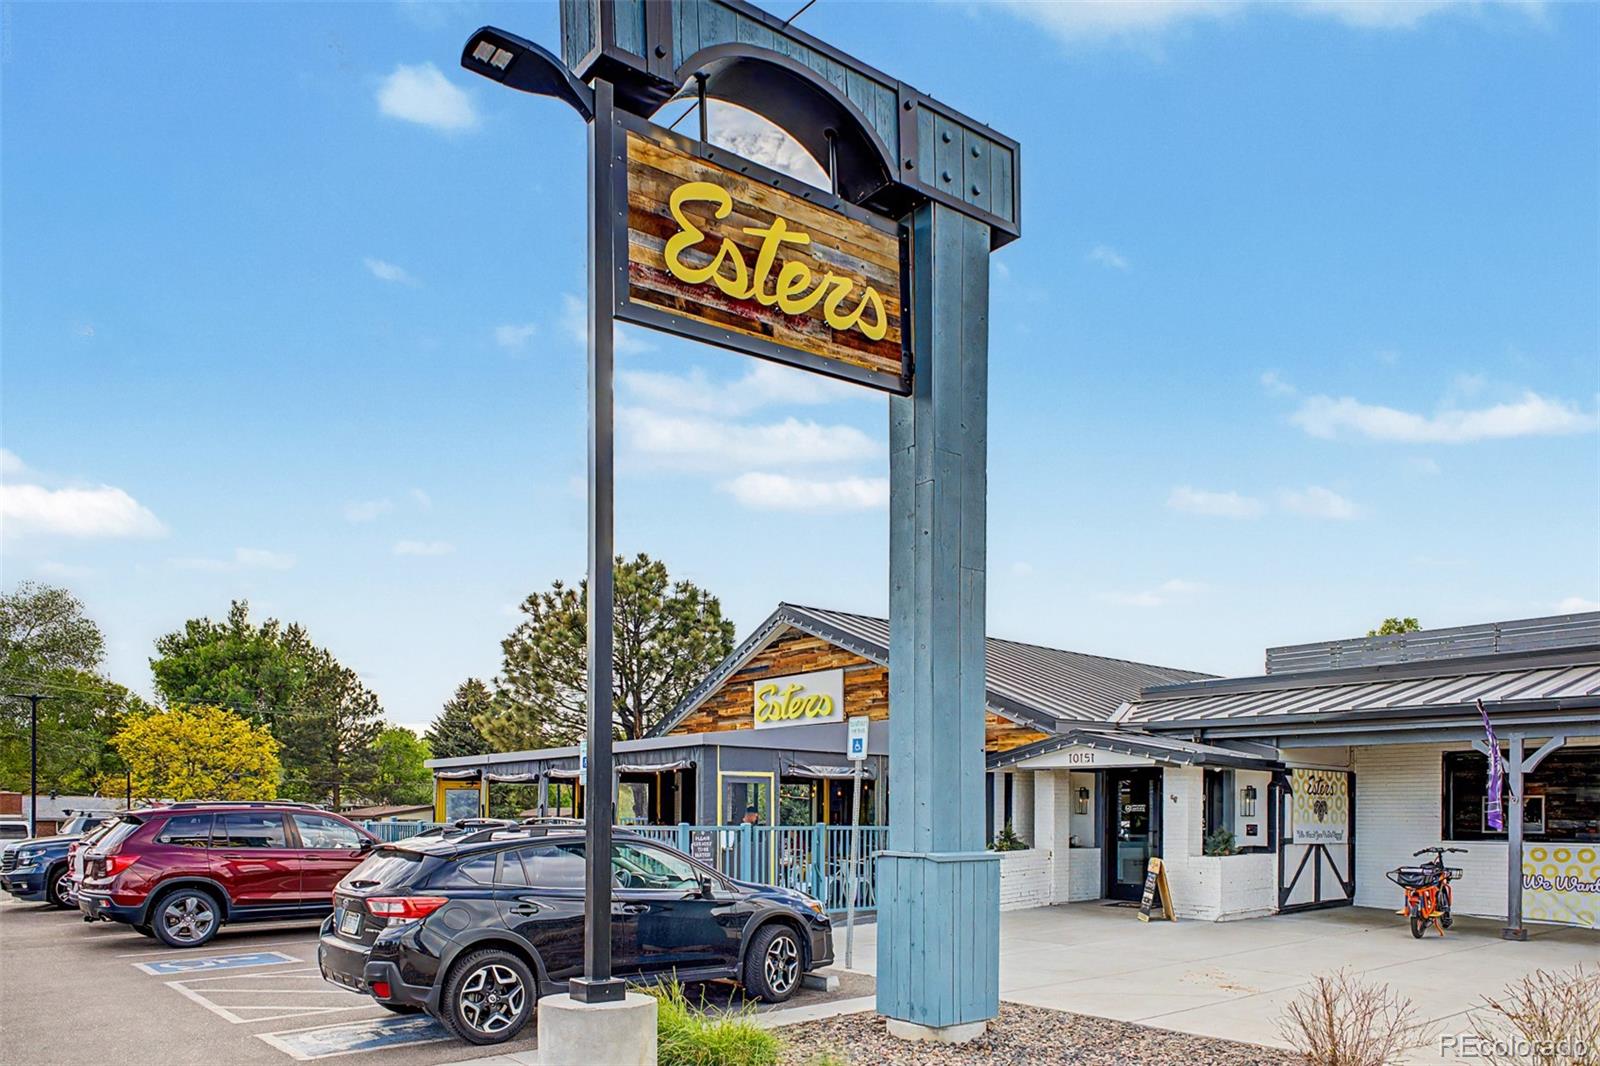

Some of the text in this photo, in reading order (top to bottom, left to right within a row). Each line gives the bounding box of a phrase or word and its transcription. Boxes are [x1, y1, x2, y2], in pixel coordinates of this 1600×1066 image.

[664, 181, 887, 341] Esters
[756, 683, 834, 723] Esters
[1069, 753, 1094, 763] 10151
[1307, 775, 1334, 796] Esters
[1522, 874, 1600, 893] We Want
